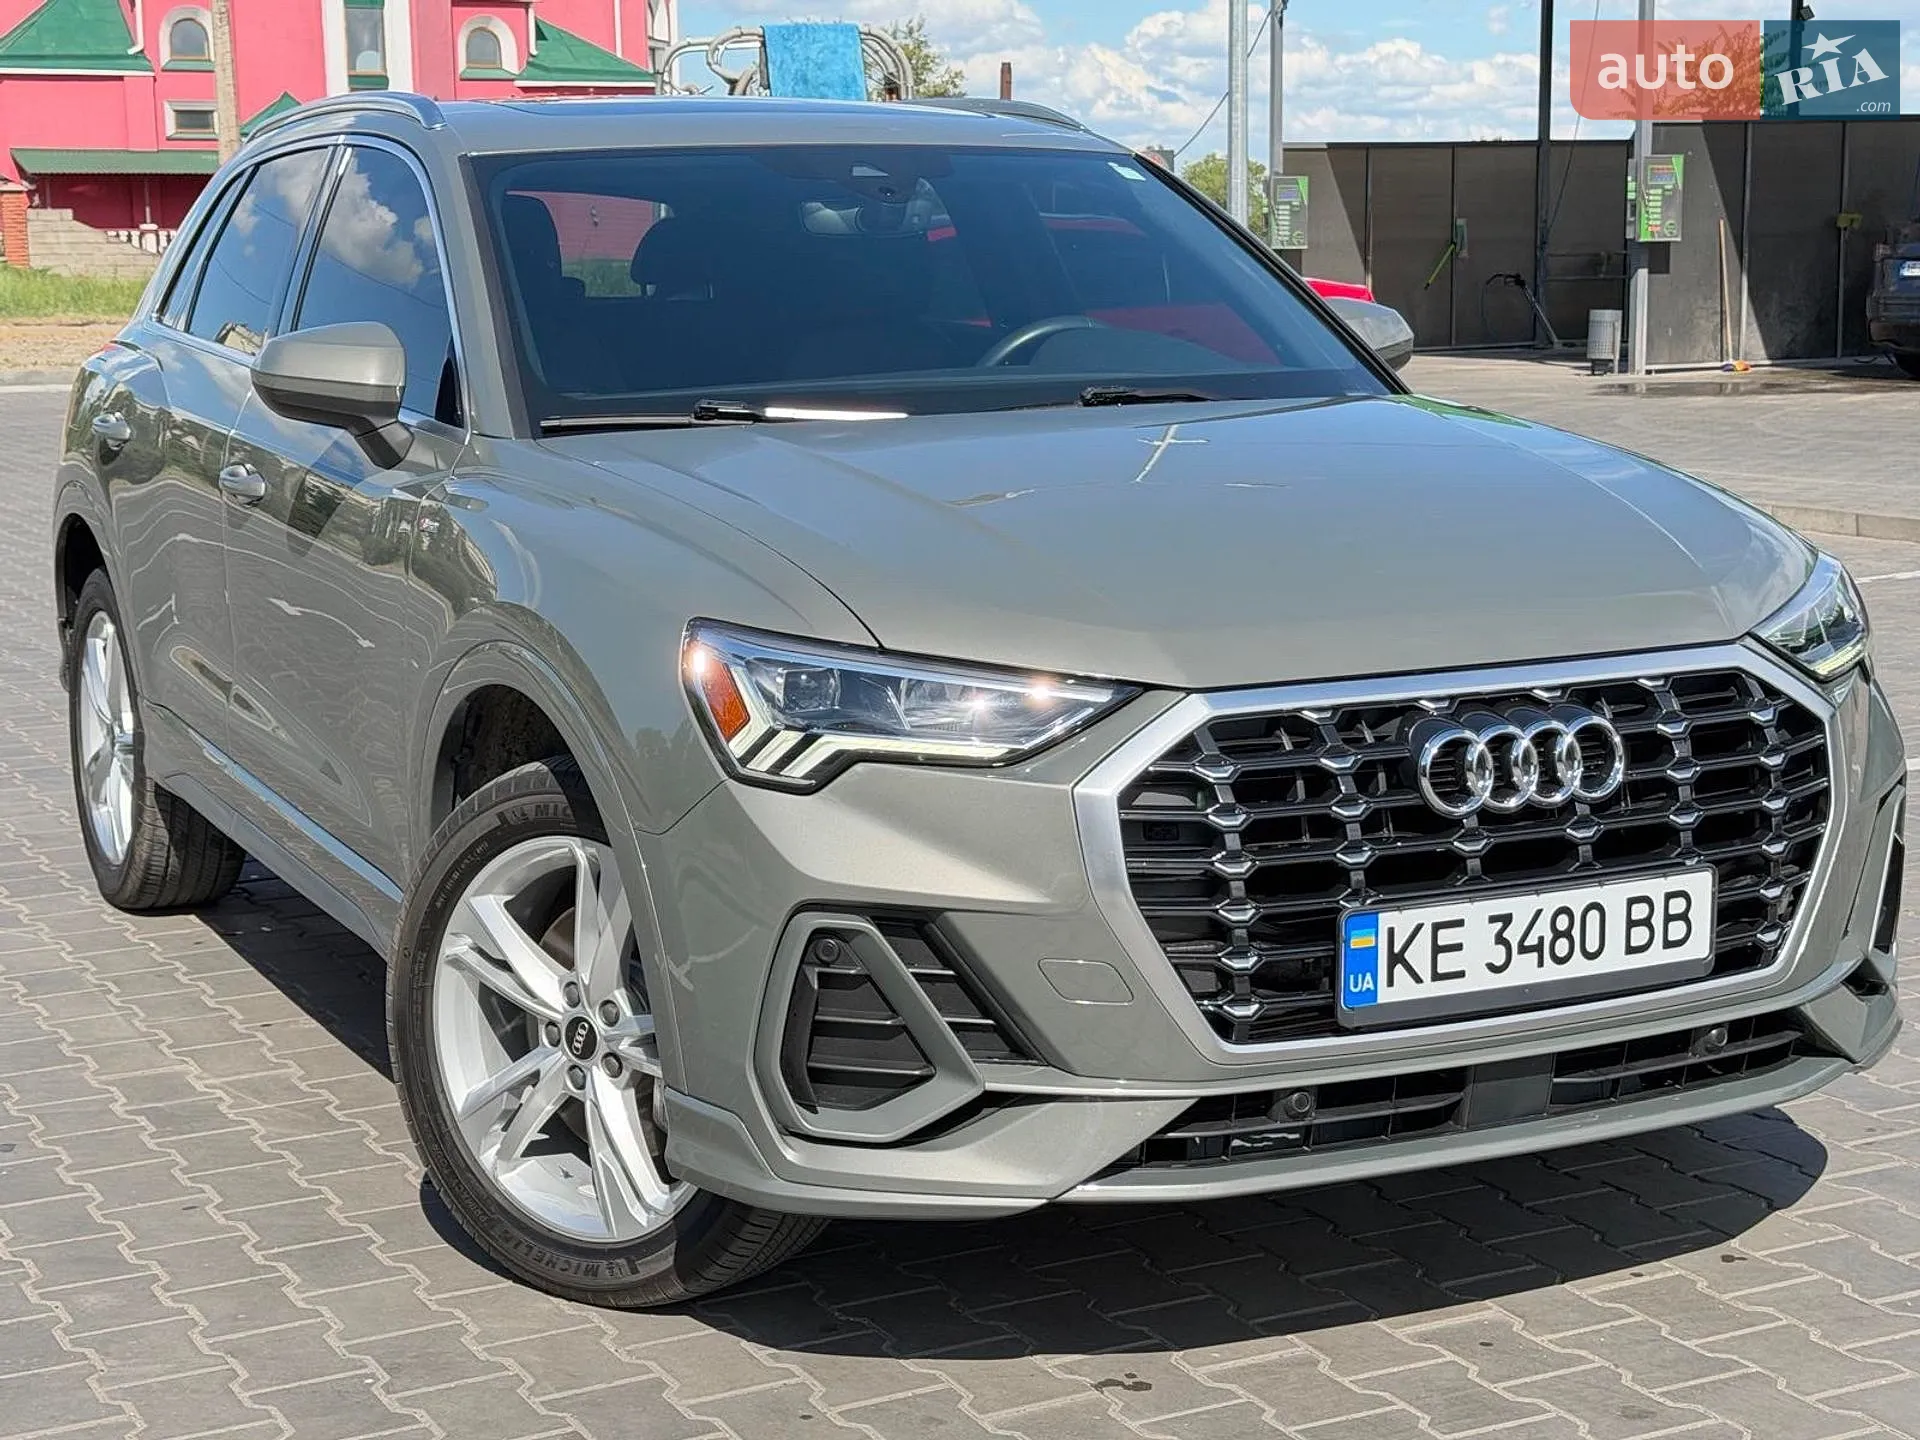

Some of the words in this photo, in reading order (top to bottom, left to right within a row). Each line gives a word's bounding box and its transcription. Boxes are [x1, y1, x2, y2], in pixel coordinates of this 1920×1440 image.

[1385, 918, 1466, 988] KE
[1485, 902, 1606, 974] 3480
[1624, 890, 1692, 956] BB
[1349, 972, 1375, 993] UA
